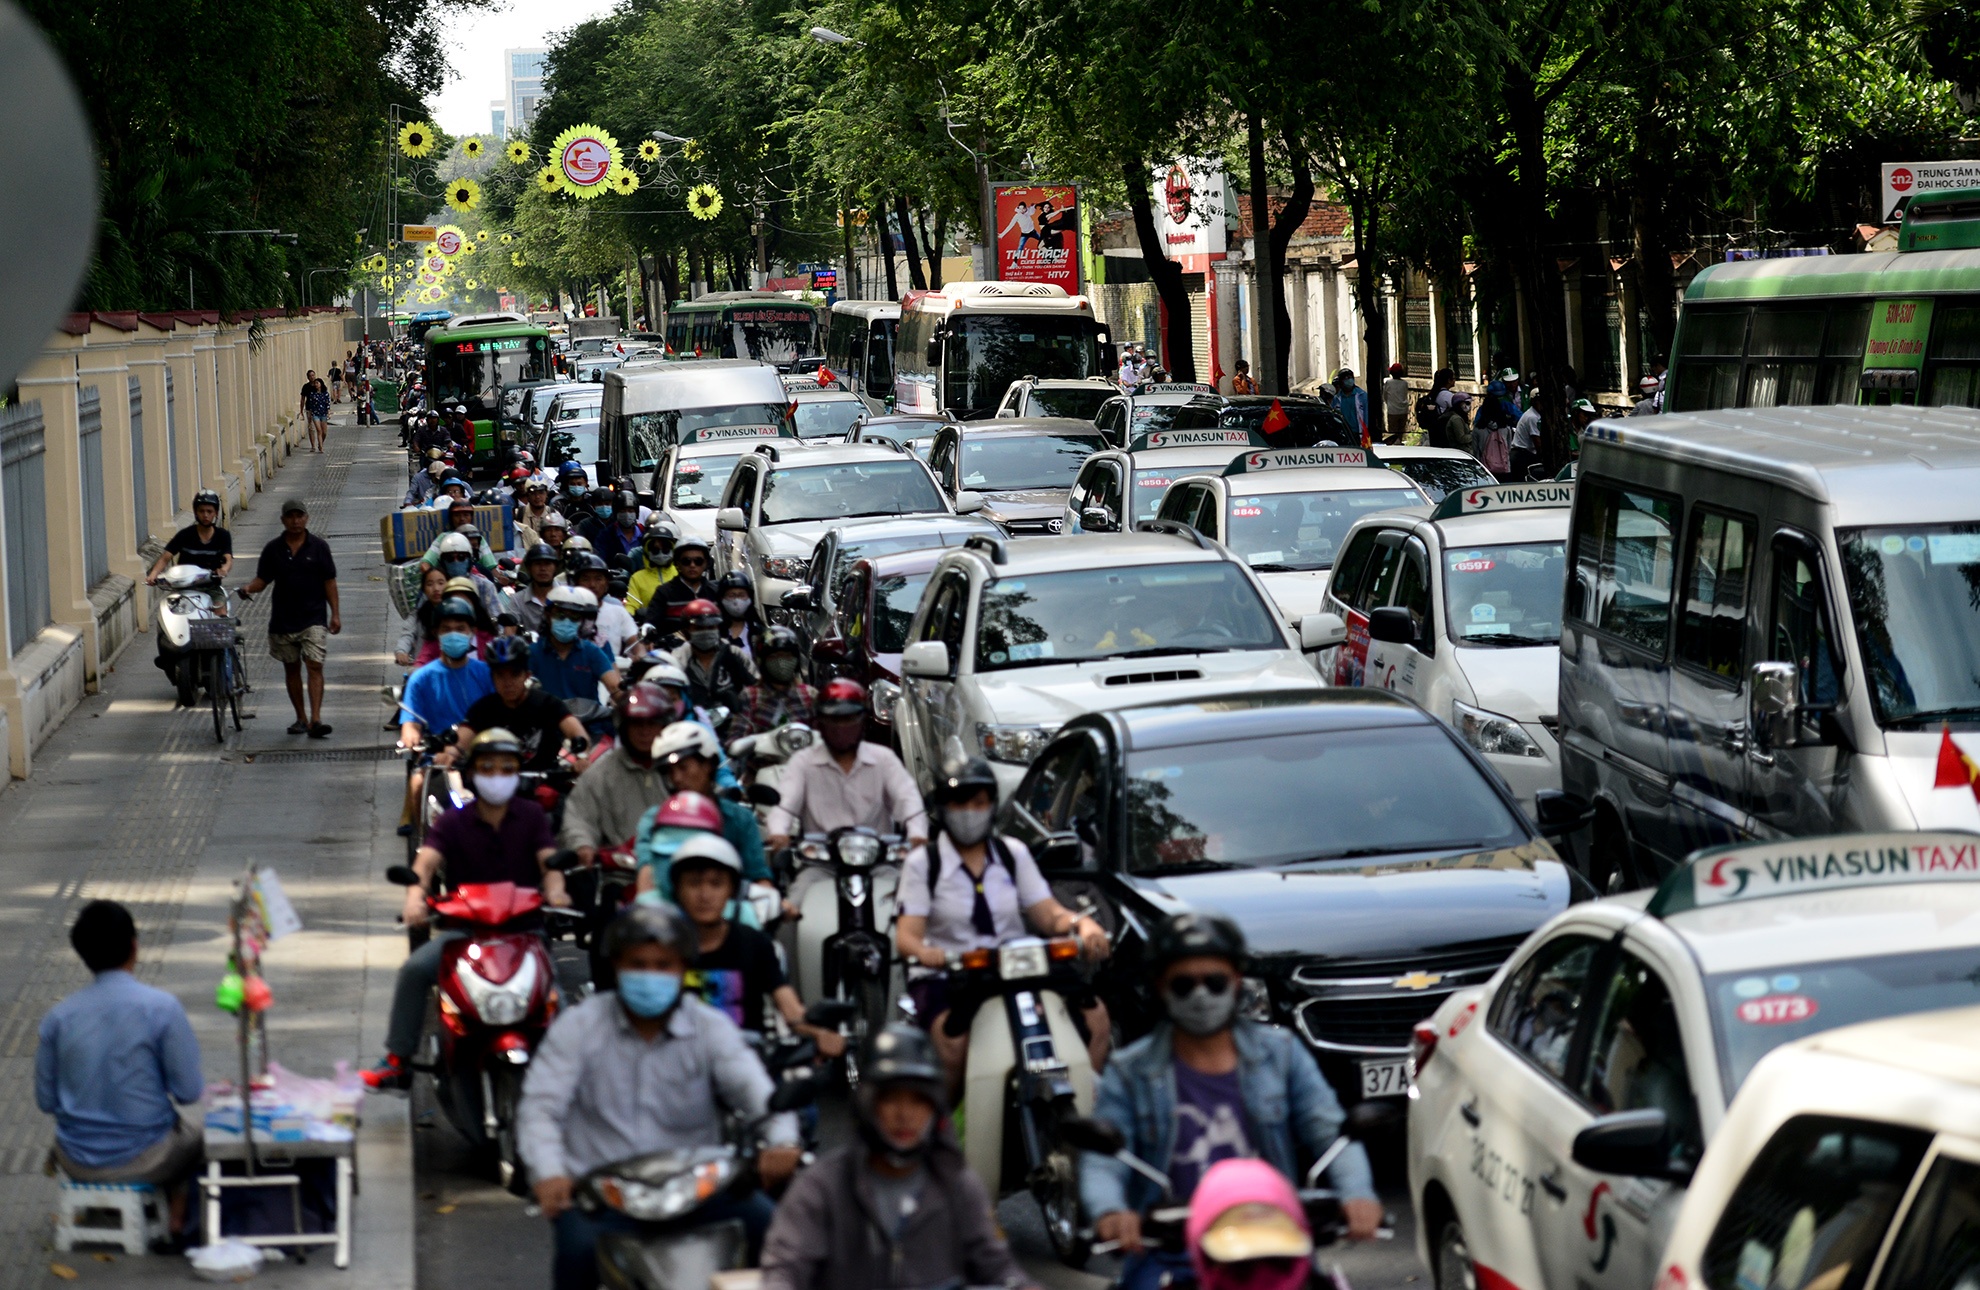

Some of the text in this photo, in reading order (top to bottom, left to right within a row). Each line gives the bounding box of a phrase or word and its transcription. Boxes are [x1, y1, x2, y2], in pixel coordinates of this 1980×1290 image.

[1917, 169, 1950, 178] TRUNG
[1953, 167, 1973, 177] TÂM
[1917, 181, 1934, 190] ĐẠI
[1935, 180, 1954, 190] HỌC
[1956, 178, 1969, 188] SƯ
[1047, 270, 1070, 279] HTV7
[766, 310, 776, 323] 5
[715, 427, 777, 437] VINASUN TAXI
[1172, 432, 1248, 443] VINASUN TAXI
[1275, 452, 1364, 466] VINASUN TAXI
[1495, 487, 1570, 504] VINASUN
[1233, 508, 1262, 516] 8844
[1458, 561, 1491, 571] 6597
[1764, 843, 1980, 883] VINASUN TAXI
[1742, 996, 1810, 1022] 9173
